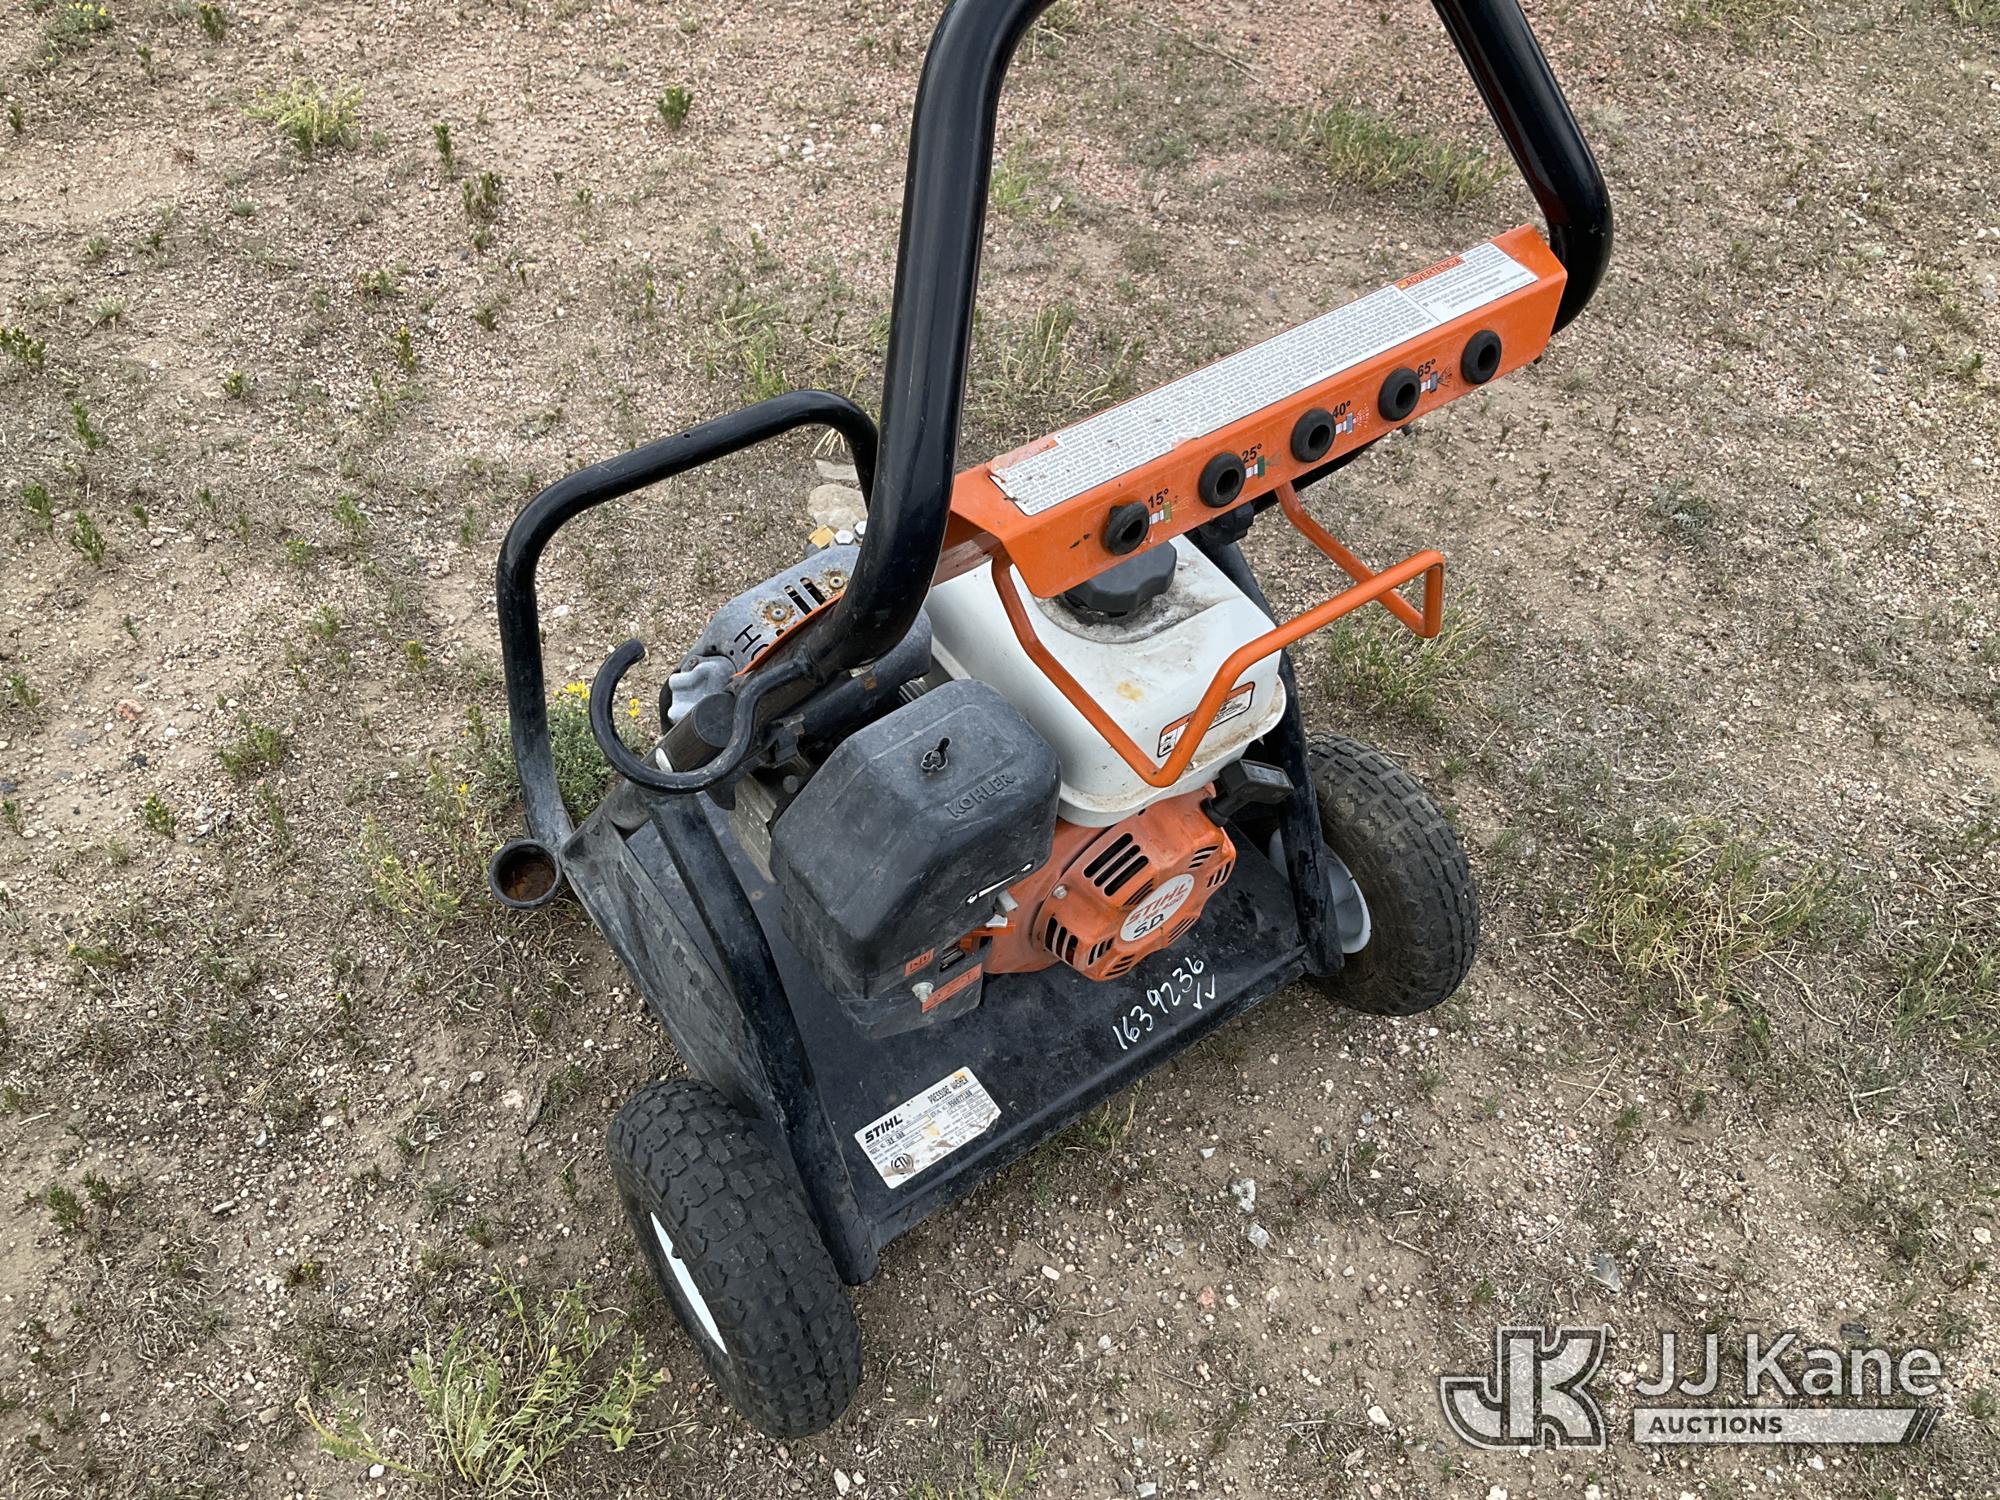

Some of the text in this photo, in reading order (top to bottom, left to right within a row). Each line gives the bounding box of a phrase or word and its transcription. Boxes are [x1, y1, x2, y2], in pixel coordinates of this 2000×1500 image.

[1406, 256, 1463, 286] ADVERTENCIA
[1148, 488, 1169, 508] 15°
[946, 774, 1015, 818] KOHLER
[1125, 883, 1189, 927] STIHL
[1112, 957, 1204, 1050] 1639236
[864, 1114, 903, 1144] STIHL
